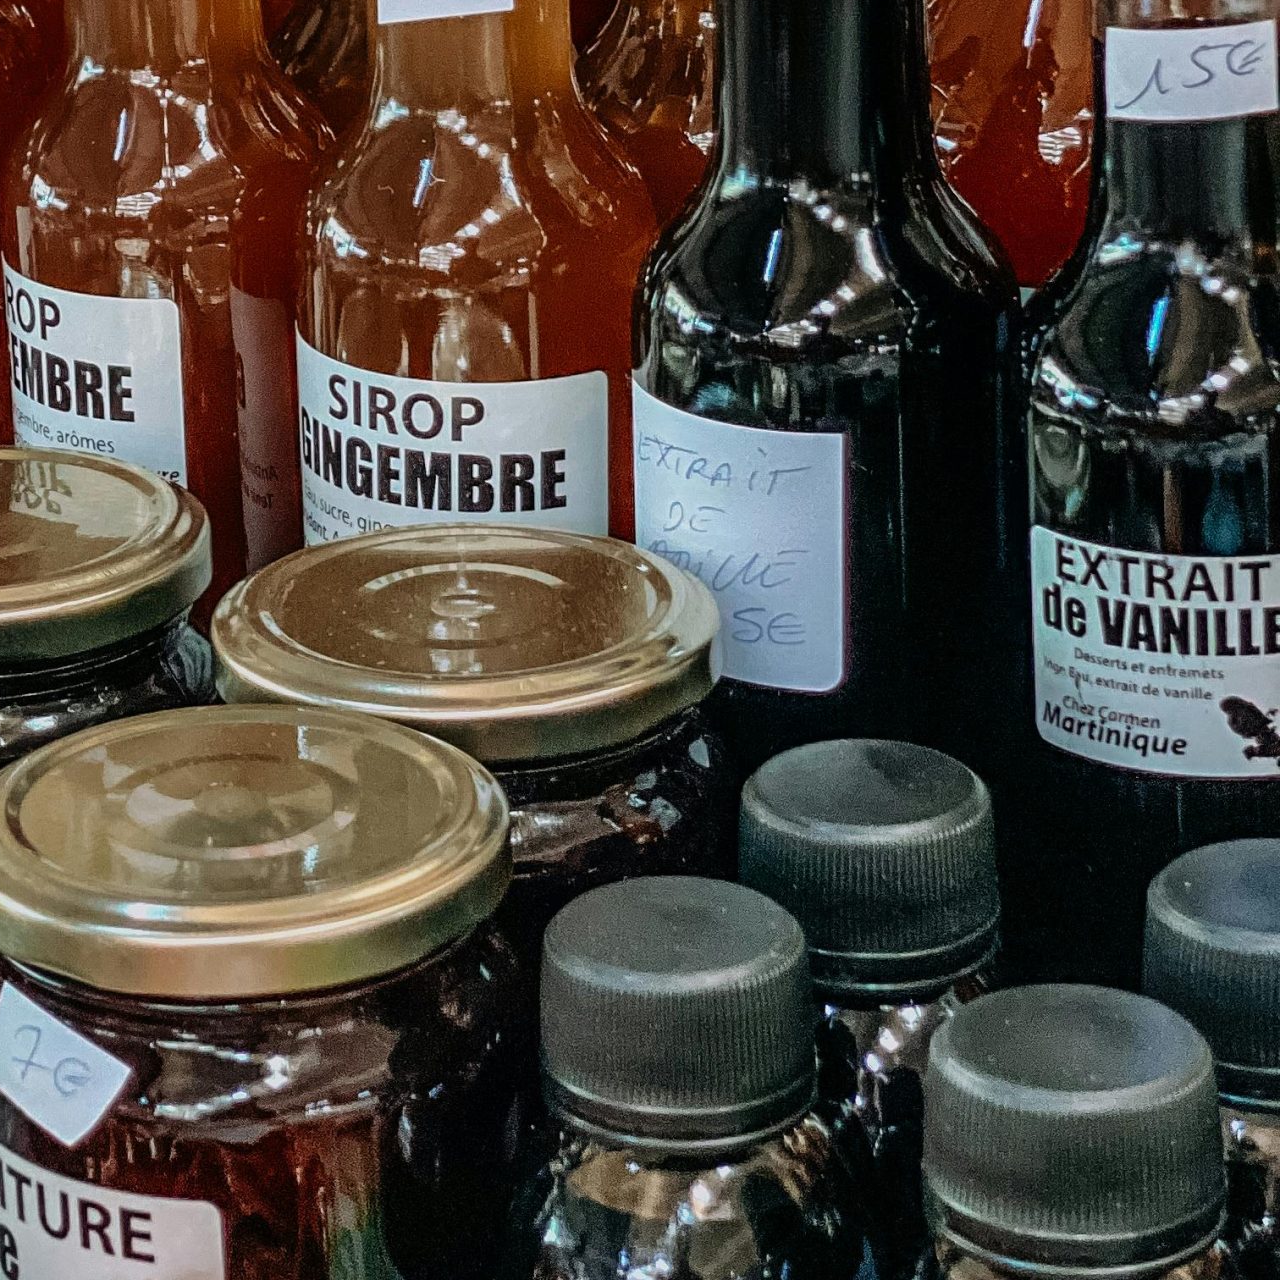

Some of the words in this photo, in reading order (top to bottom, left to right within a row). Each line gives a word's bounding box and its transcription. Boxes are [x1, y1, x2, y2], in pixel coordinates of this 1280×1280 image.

[328, 373, 485, 442] SIROP
[57, 428, 116, 454] arômes
[301, 405, 567, 514] GINGEMBRE
[320, 498, 353, 528] sucre,
[1055, 537, 1272, 603] EXTRAIT
[1042, 582, 1087, 638] de
[1097, 595, 1280, 657] VANILLE
[1074, 647, 1128, 671] Desserts
[1131, 661, 1145, 675] et
[1148, 664, 1225, 681] entremets
[1095, 676, 1140, 694] extrait
[1141, 682, 1160, 698] de
[1163, 685, 1214, 701] vanille
[1043, 700, 1189, 758] Martinique
[1062, 694, 1096, 717] Chez
[11, 1024, 94, 1098] 7€
